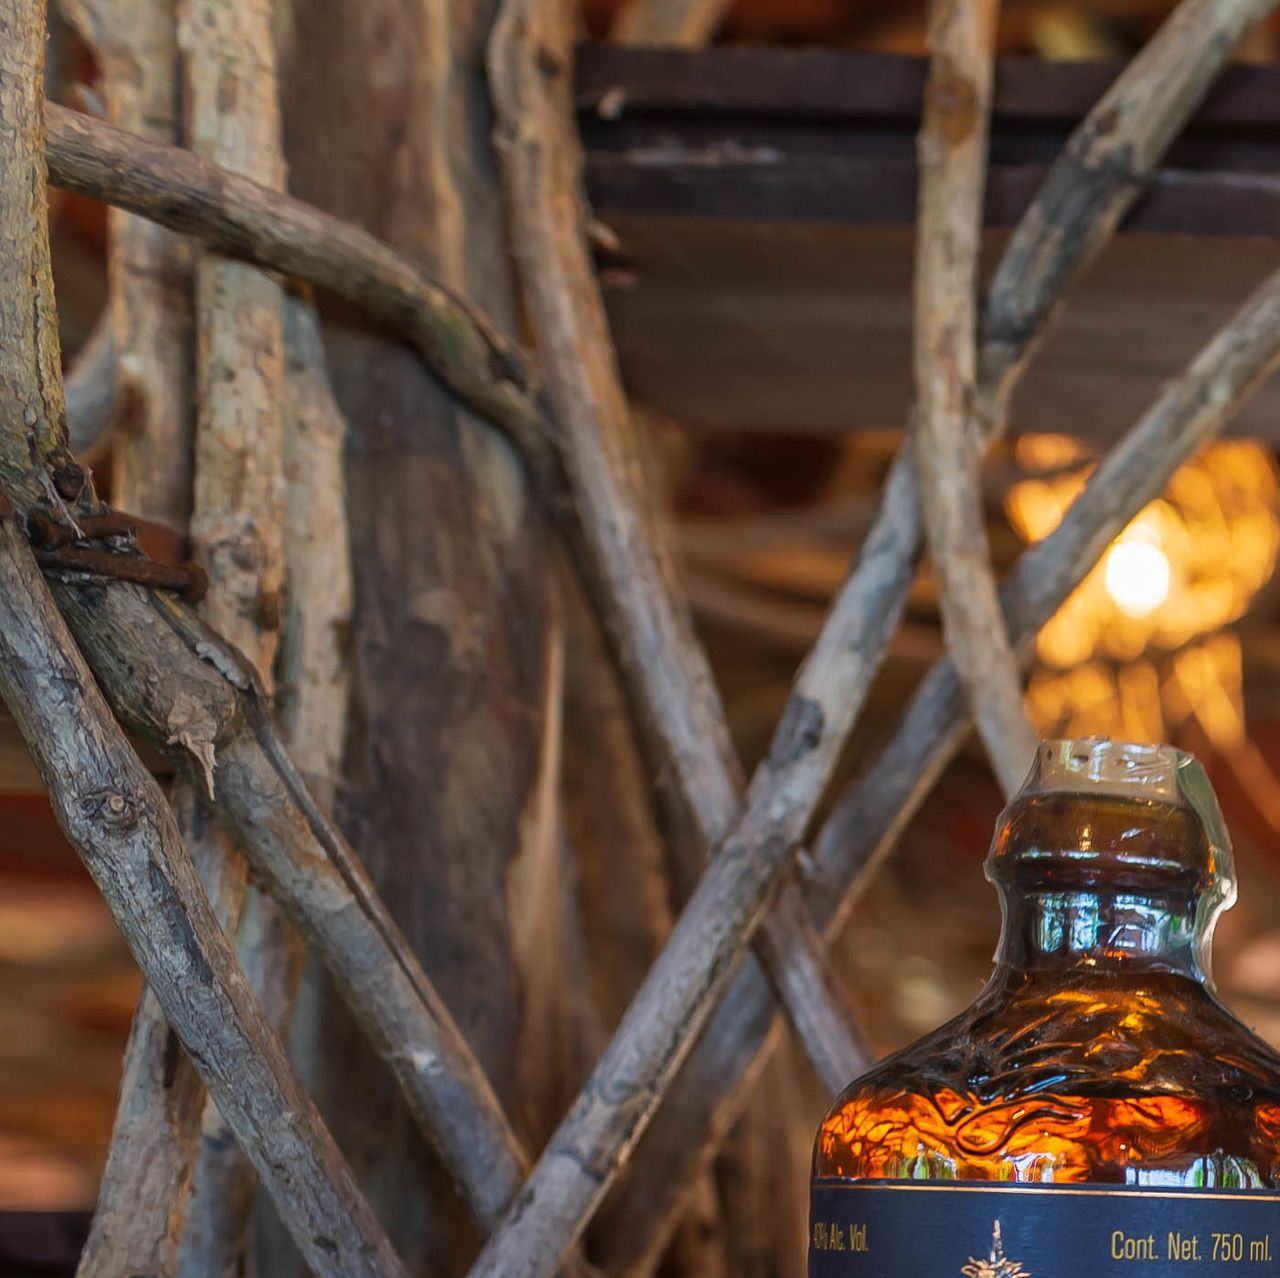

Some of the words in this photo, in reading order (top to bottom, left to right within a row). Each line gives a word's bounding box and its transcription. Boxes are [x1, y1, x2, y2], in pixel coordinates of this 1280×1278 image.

[1112, 1230, 1158, 1262] Cont.
[1167, 1233, 1201, 1262] Net.
[1211, 1232, 1244, 1262] 750
